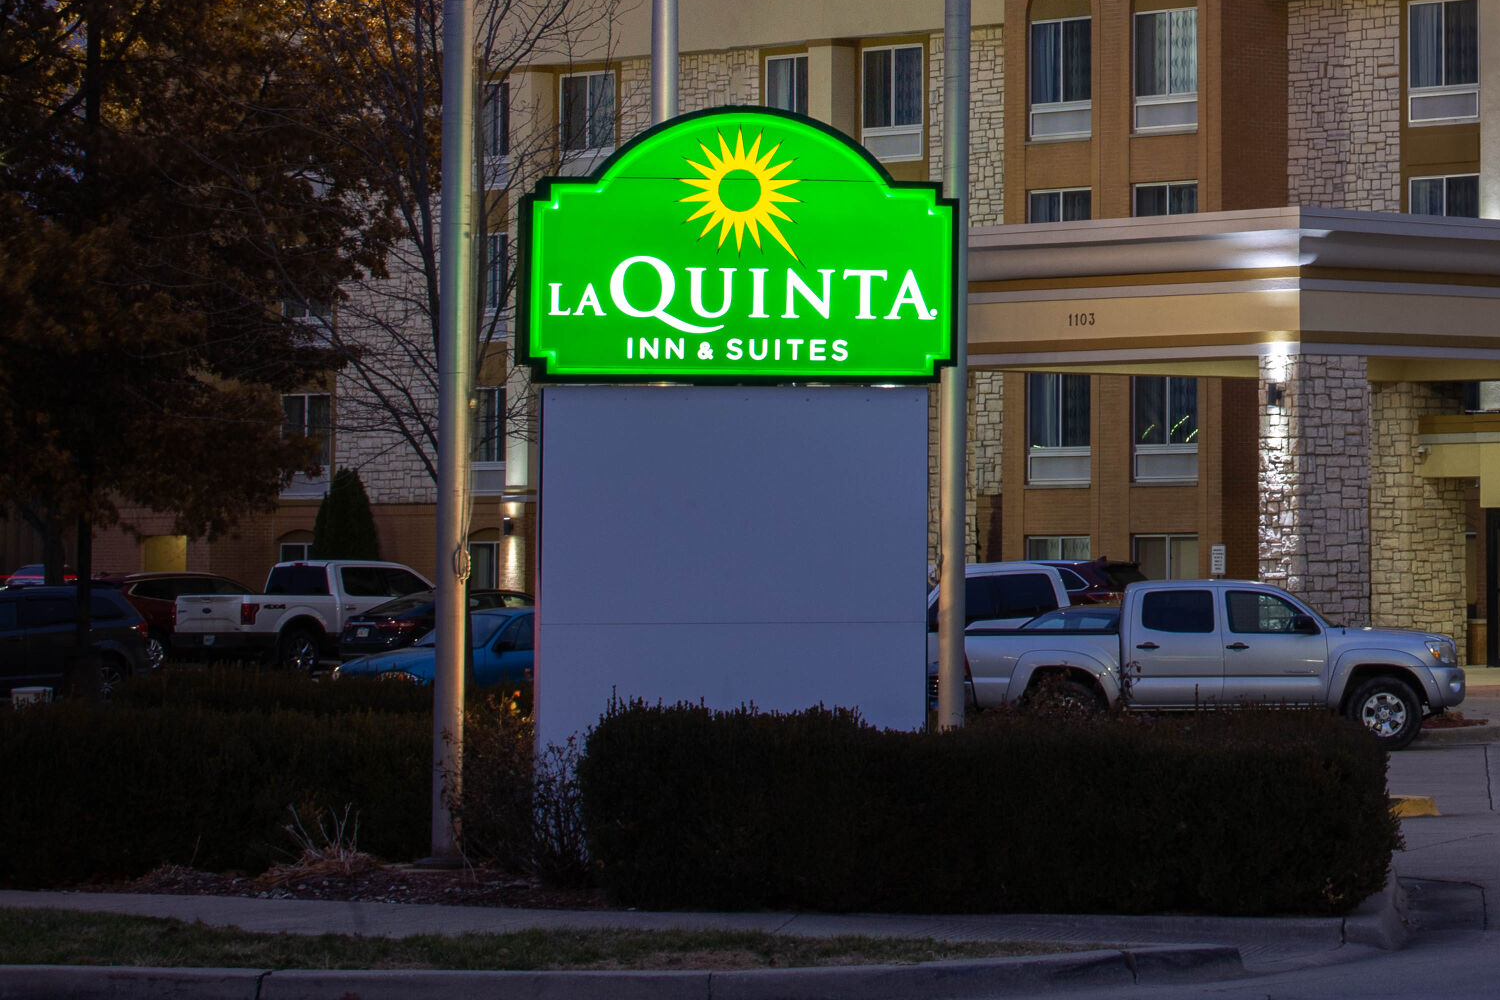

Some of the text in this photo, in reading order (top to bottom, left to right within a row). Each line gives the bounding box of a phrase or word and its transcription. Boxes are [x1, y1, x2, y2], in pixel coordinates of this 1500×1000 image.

[1068, 312, 1096, 327] 1103
[627, 337, 849, 362] INN & SUITES
